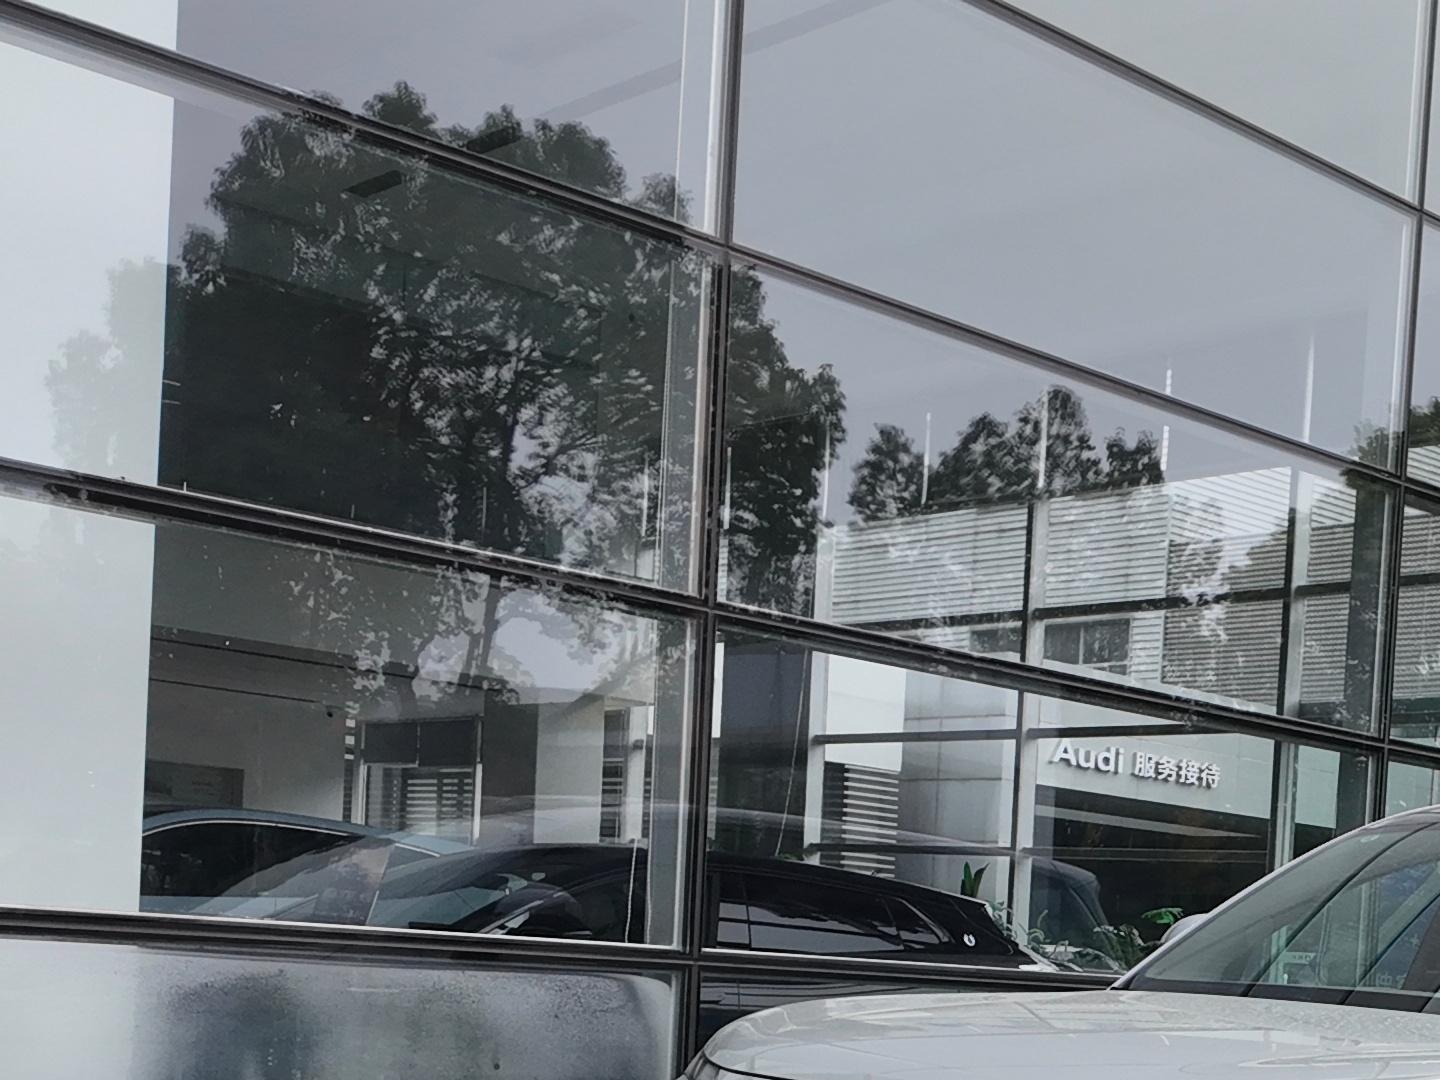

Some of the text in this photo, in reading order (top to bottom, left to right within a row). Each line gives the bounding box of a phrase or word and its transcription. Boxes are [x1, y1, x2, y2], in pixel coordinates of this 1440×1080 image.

[1052, 740, 1221, 788] Audi 服务接待
